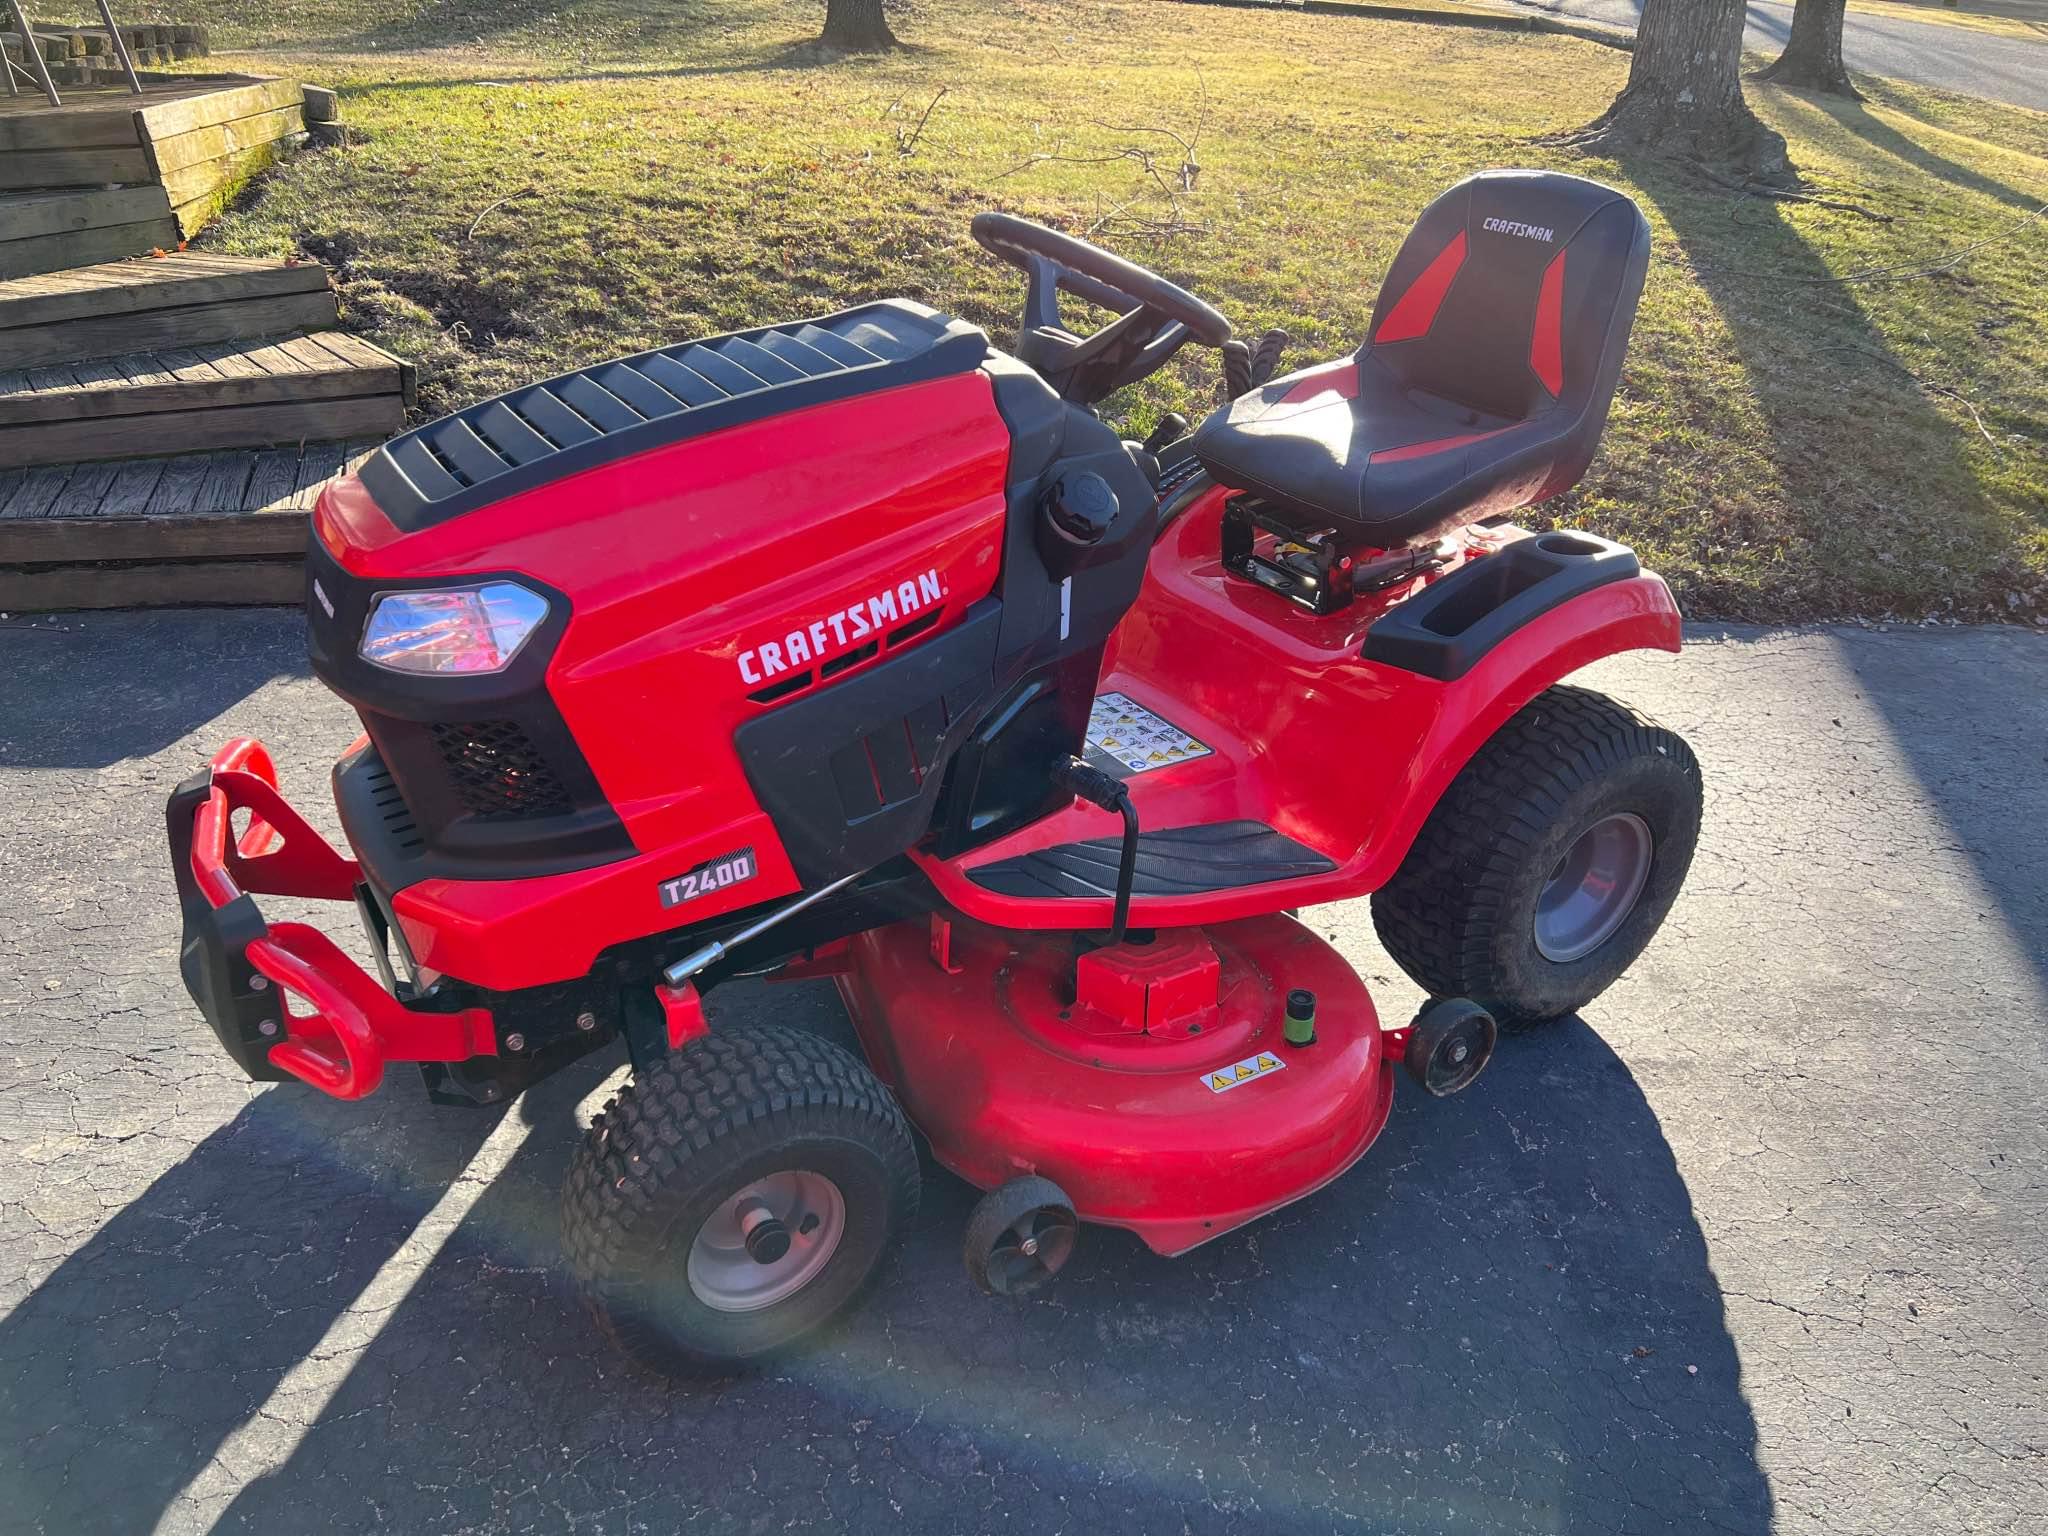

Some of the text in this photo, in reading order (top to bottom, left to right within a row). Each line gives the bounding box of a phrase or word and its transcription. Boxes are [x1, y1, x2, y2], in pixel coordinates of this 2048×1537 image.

[1482, 217, 1554, 243] CRAFTSMAN
[737, 568, 944, 685] CRAFTSMAN
[664, 857, 750, 904] T2400
